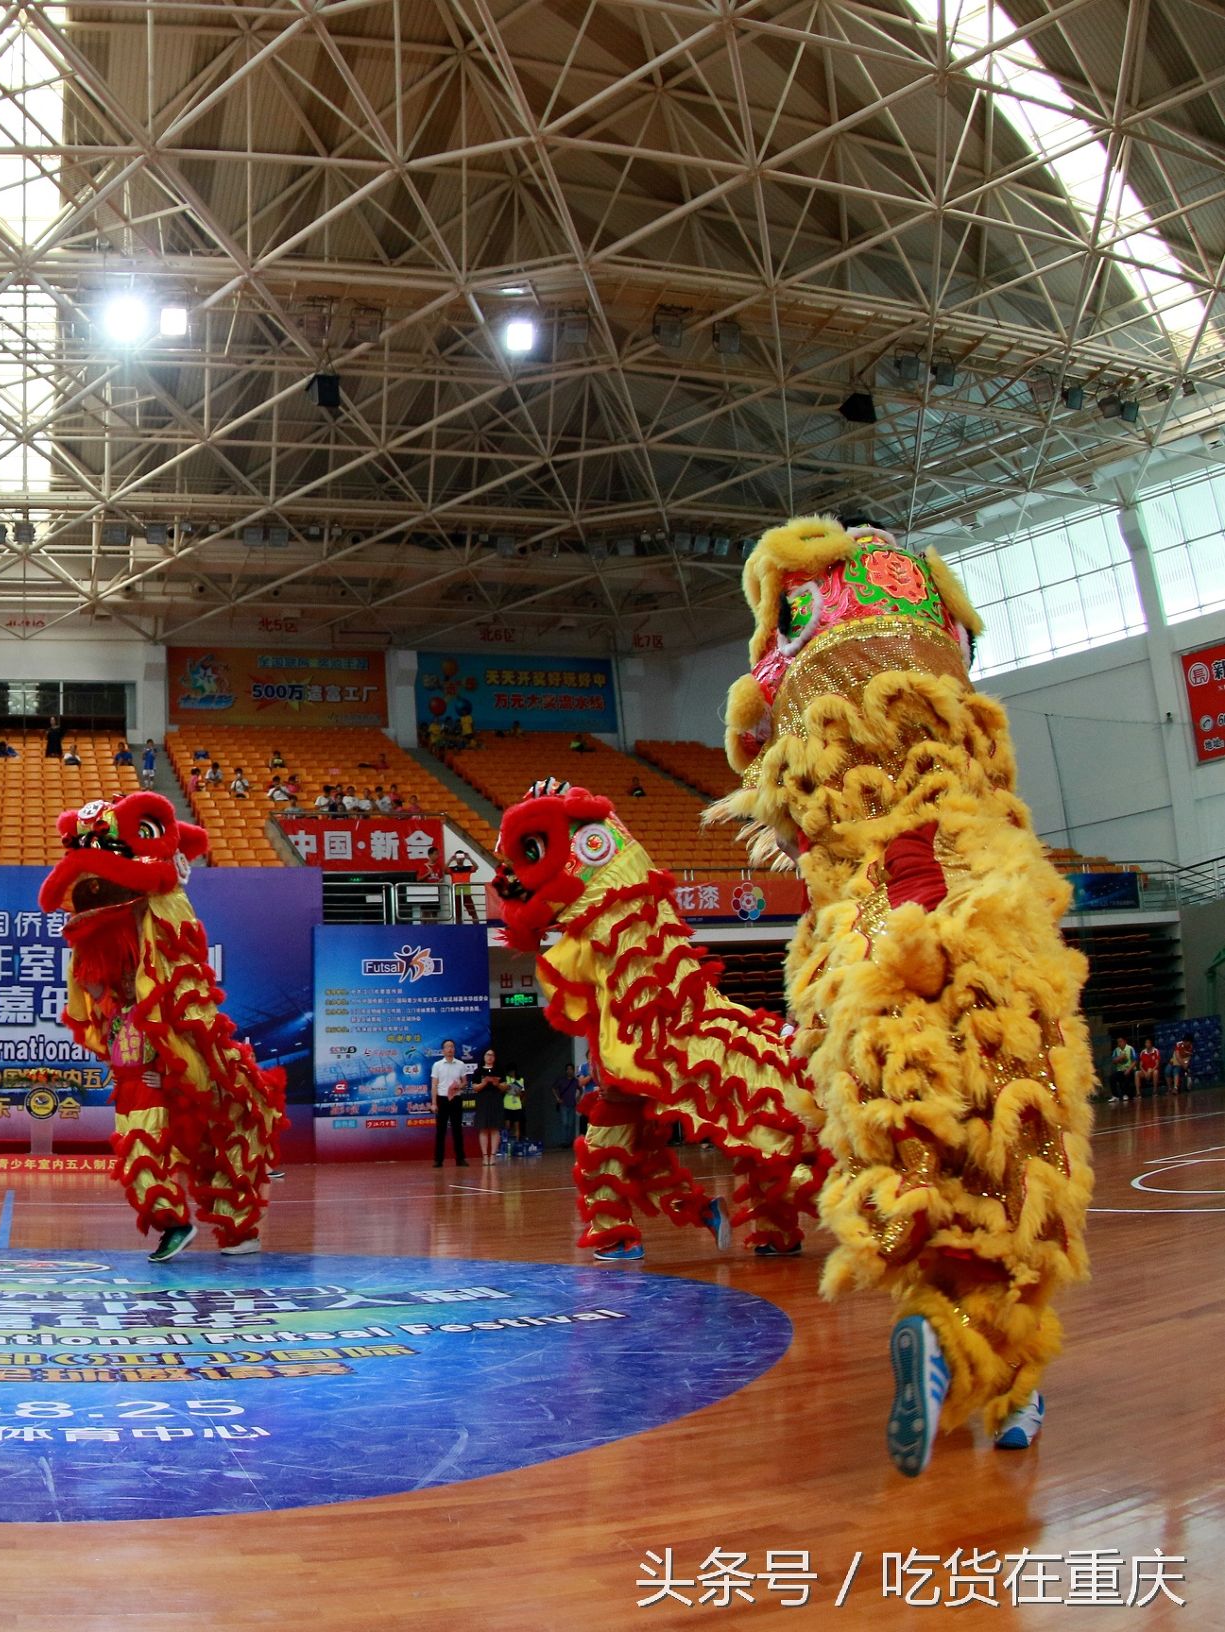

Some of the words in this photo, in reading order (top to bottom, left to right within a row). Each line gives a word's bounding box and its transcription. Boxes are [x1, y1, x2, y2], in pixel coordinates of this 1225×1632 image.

[365, 961, 401, 973] Futsal
[206, 1327, 393, 1344] Futsal
[400, 1309, 627, 1336] Festival
